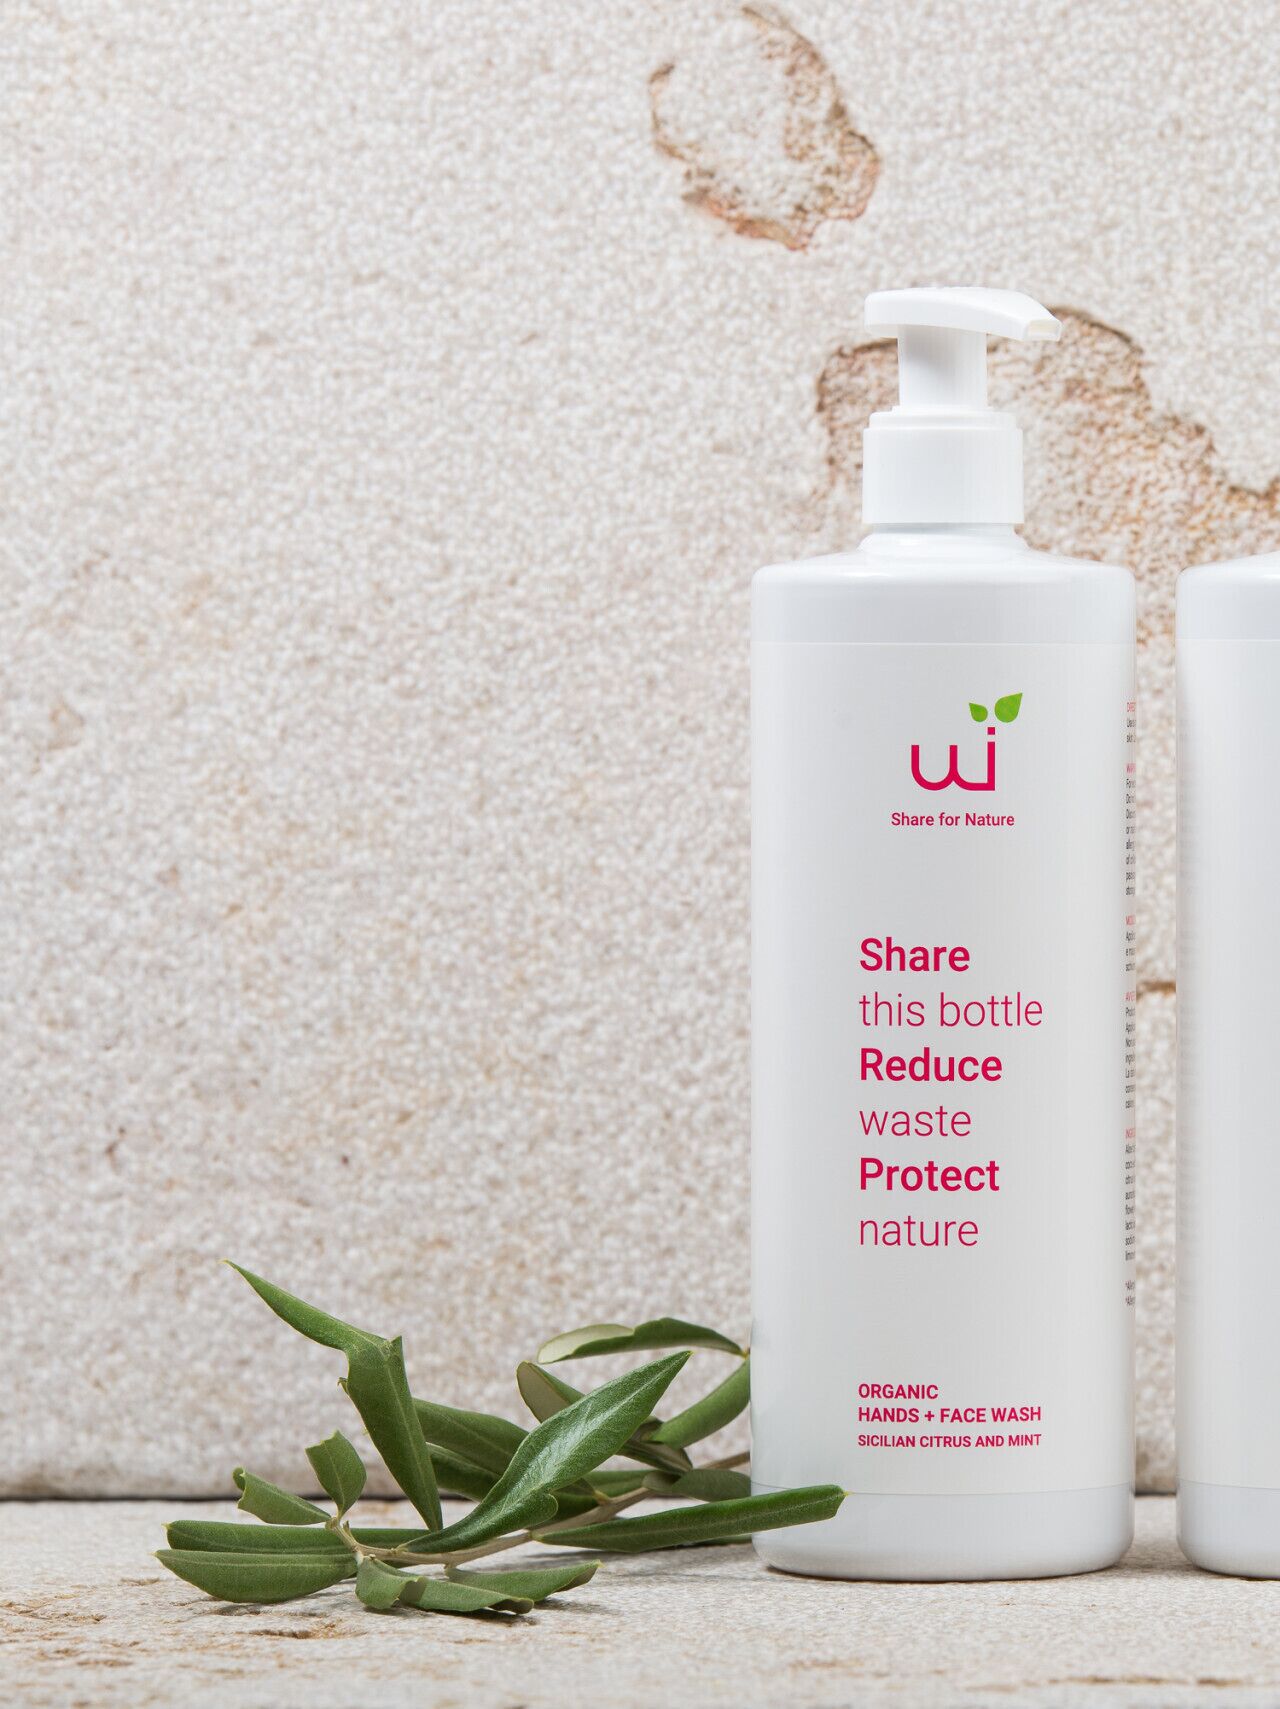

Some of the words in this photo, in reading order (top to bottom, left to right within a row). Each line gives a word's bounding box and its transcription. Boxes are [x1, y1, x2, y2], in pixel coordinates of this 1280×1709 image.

[890, 811, 935, 827] Share
[939, 811, 960, 827] for
[964, 812, 1015, 827] Nature
[860, 936, 970, 973] Share
[860, 992, 926, 1027] this
[939, 992, 1043, 1028] bottle
[860, 1046, 1003, 1083] Reduce
[859, 1105, 972, 1137] waste
[860, 1156, 1000, 1192] Protect
[859, 1216, 980, 1247] nature
[858, 1382, 938, 1400] ORGANIC
[858, 1406, 920, 1423] HANDS
[924, 1410, 936, 1422] +
[939, 1407, 986, 1424] FACE
[991, 1406, 1041, 1423] WASH
[858, 1434, 917, 1448] SICILIAN
[919, 1435, 972, 1449] CITRUS
[974, 1435, 1004, 1448] AND
[1007, 1433, 1041, 1447] MINT
